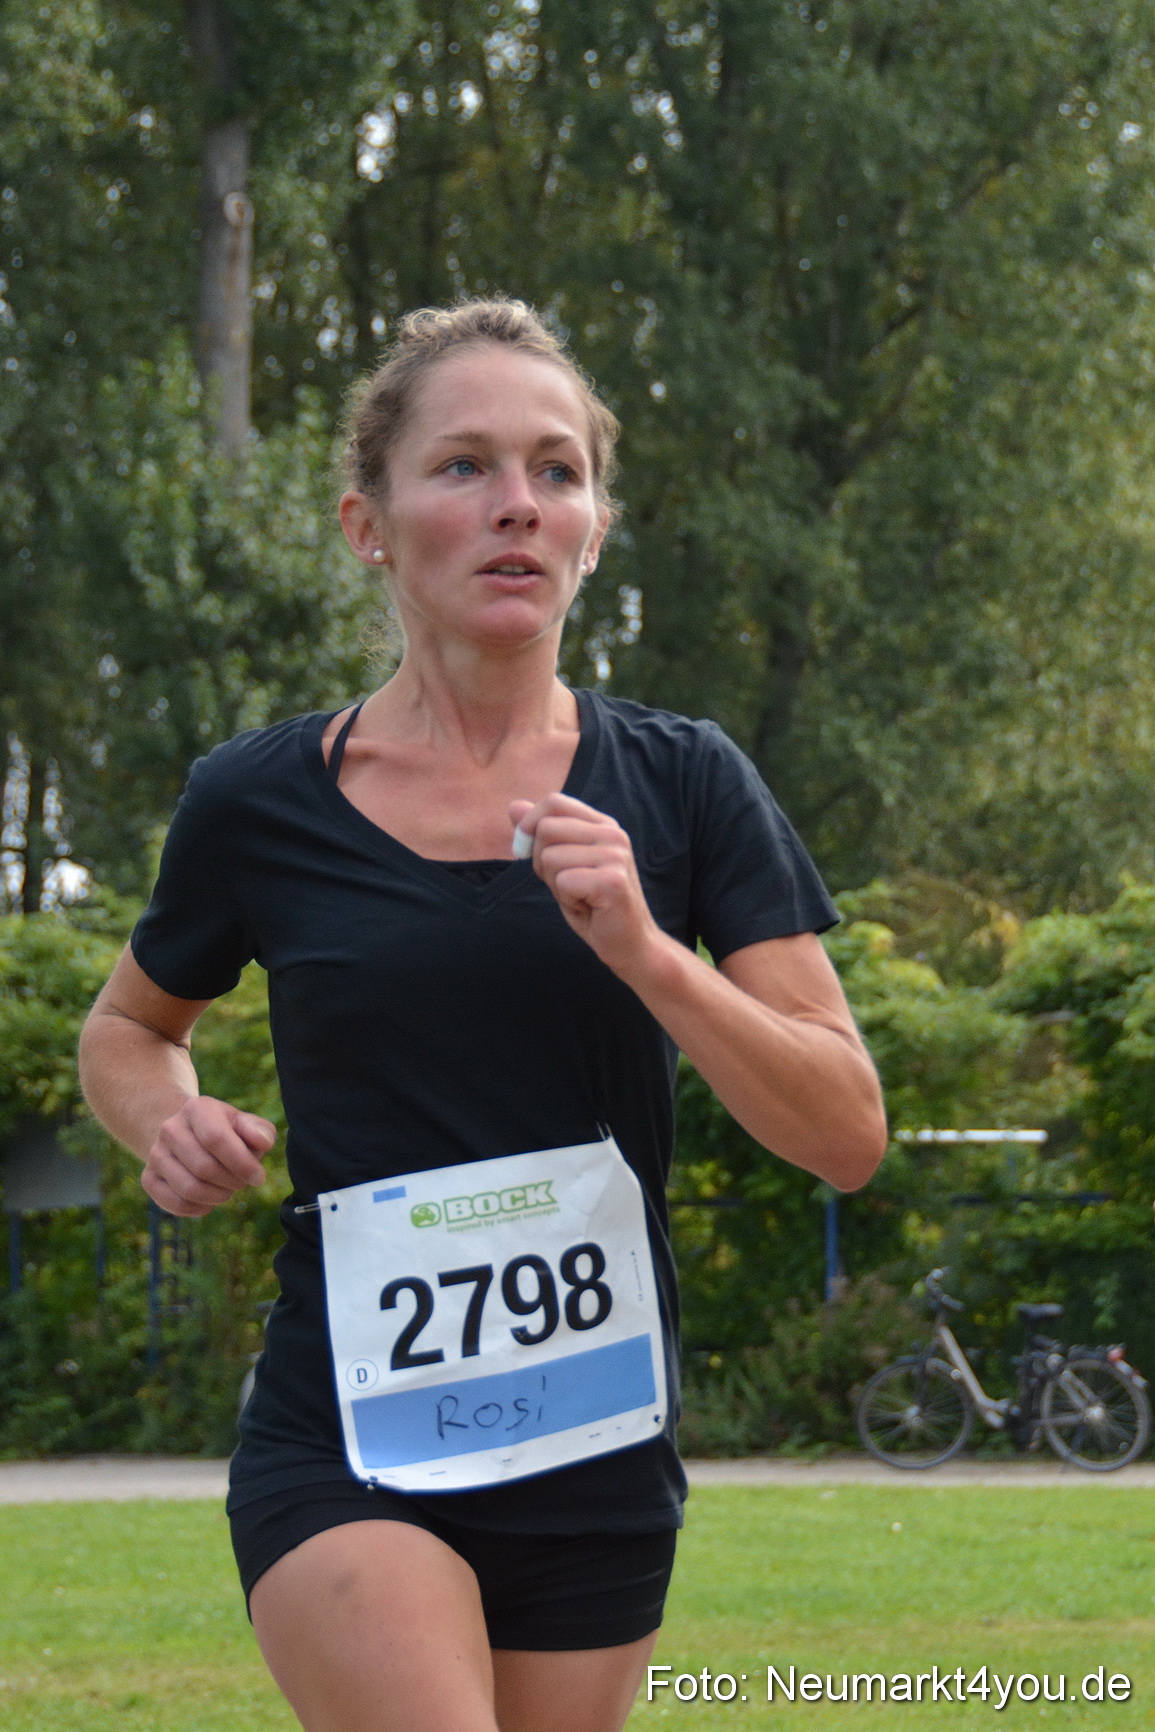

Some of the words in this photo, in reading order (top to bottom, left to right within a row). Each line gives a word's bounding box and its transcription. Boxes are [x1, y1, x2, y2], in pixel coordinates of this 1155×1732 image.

[443, 1180, 558, 1223] BOCK
[447, 1221, 483, 1233] inspired
[484, 1219, 495, 1228] by
[523, 1207, 560, 1218] concepts
[379, 1241, 613, 1372] 2798
[355, 1367, 369, 1384] D
